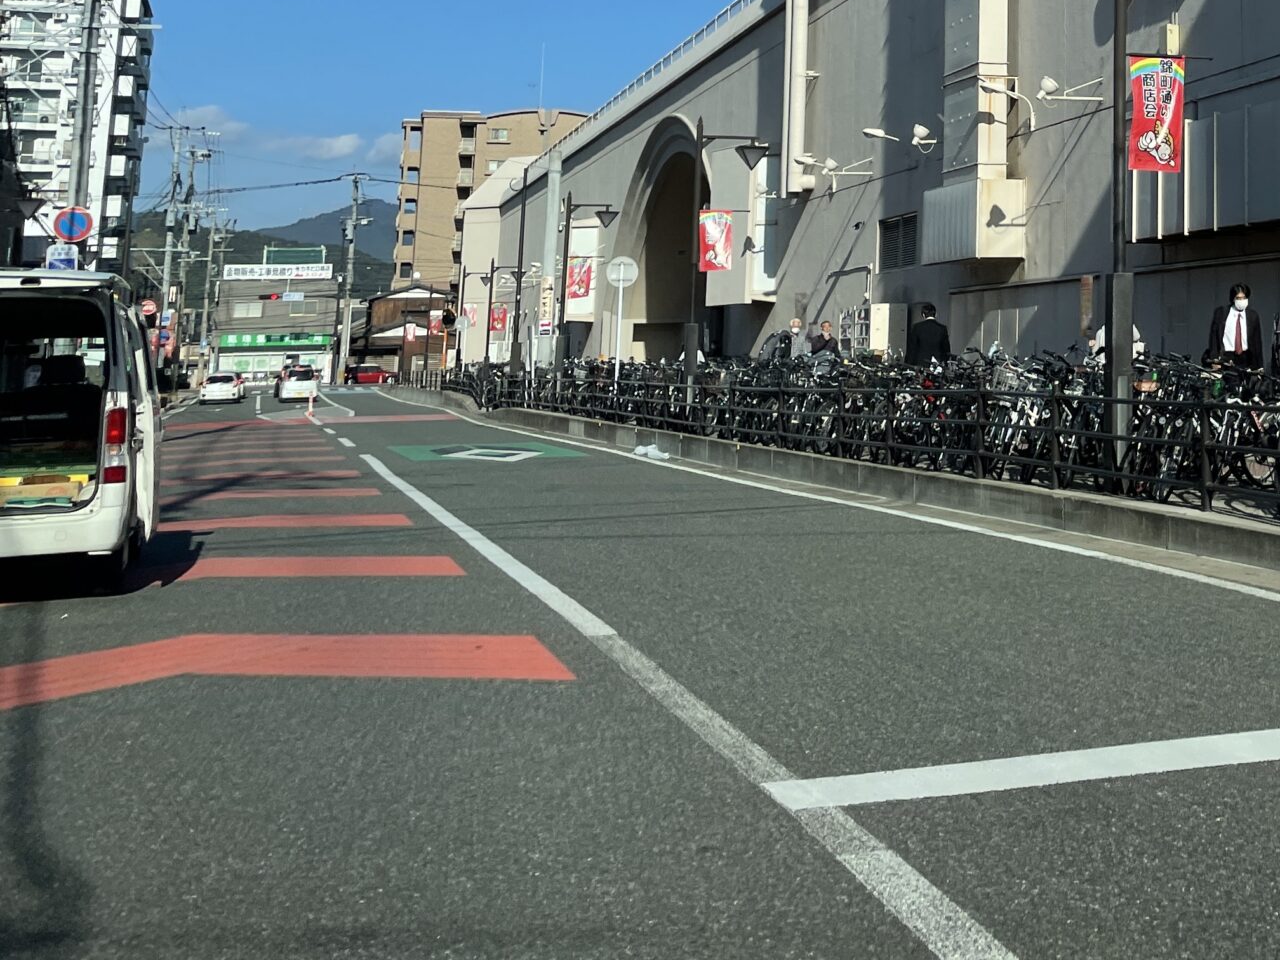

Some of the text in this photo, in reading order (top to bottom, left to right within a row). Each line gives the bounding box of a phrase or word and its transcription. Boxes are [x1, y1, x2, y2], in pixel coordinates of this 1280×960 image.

[1142, 73, 1157, 119] 商店会
[1159, 58, 1173, 119] 錦町通り
